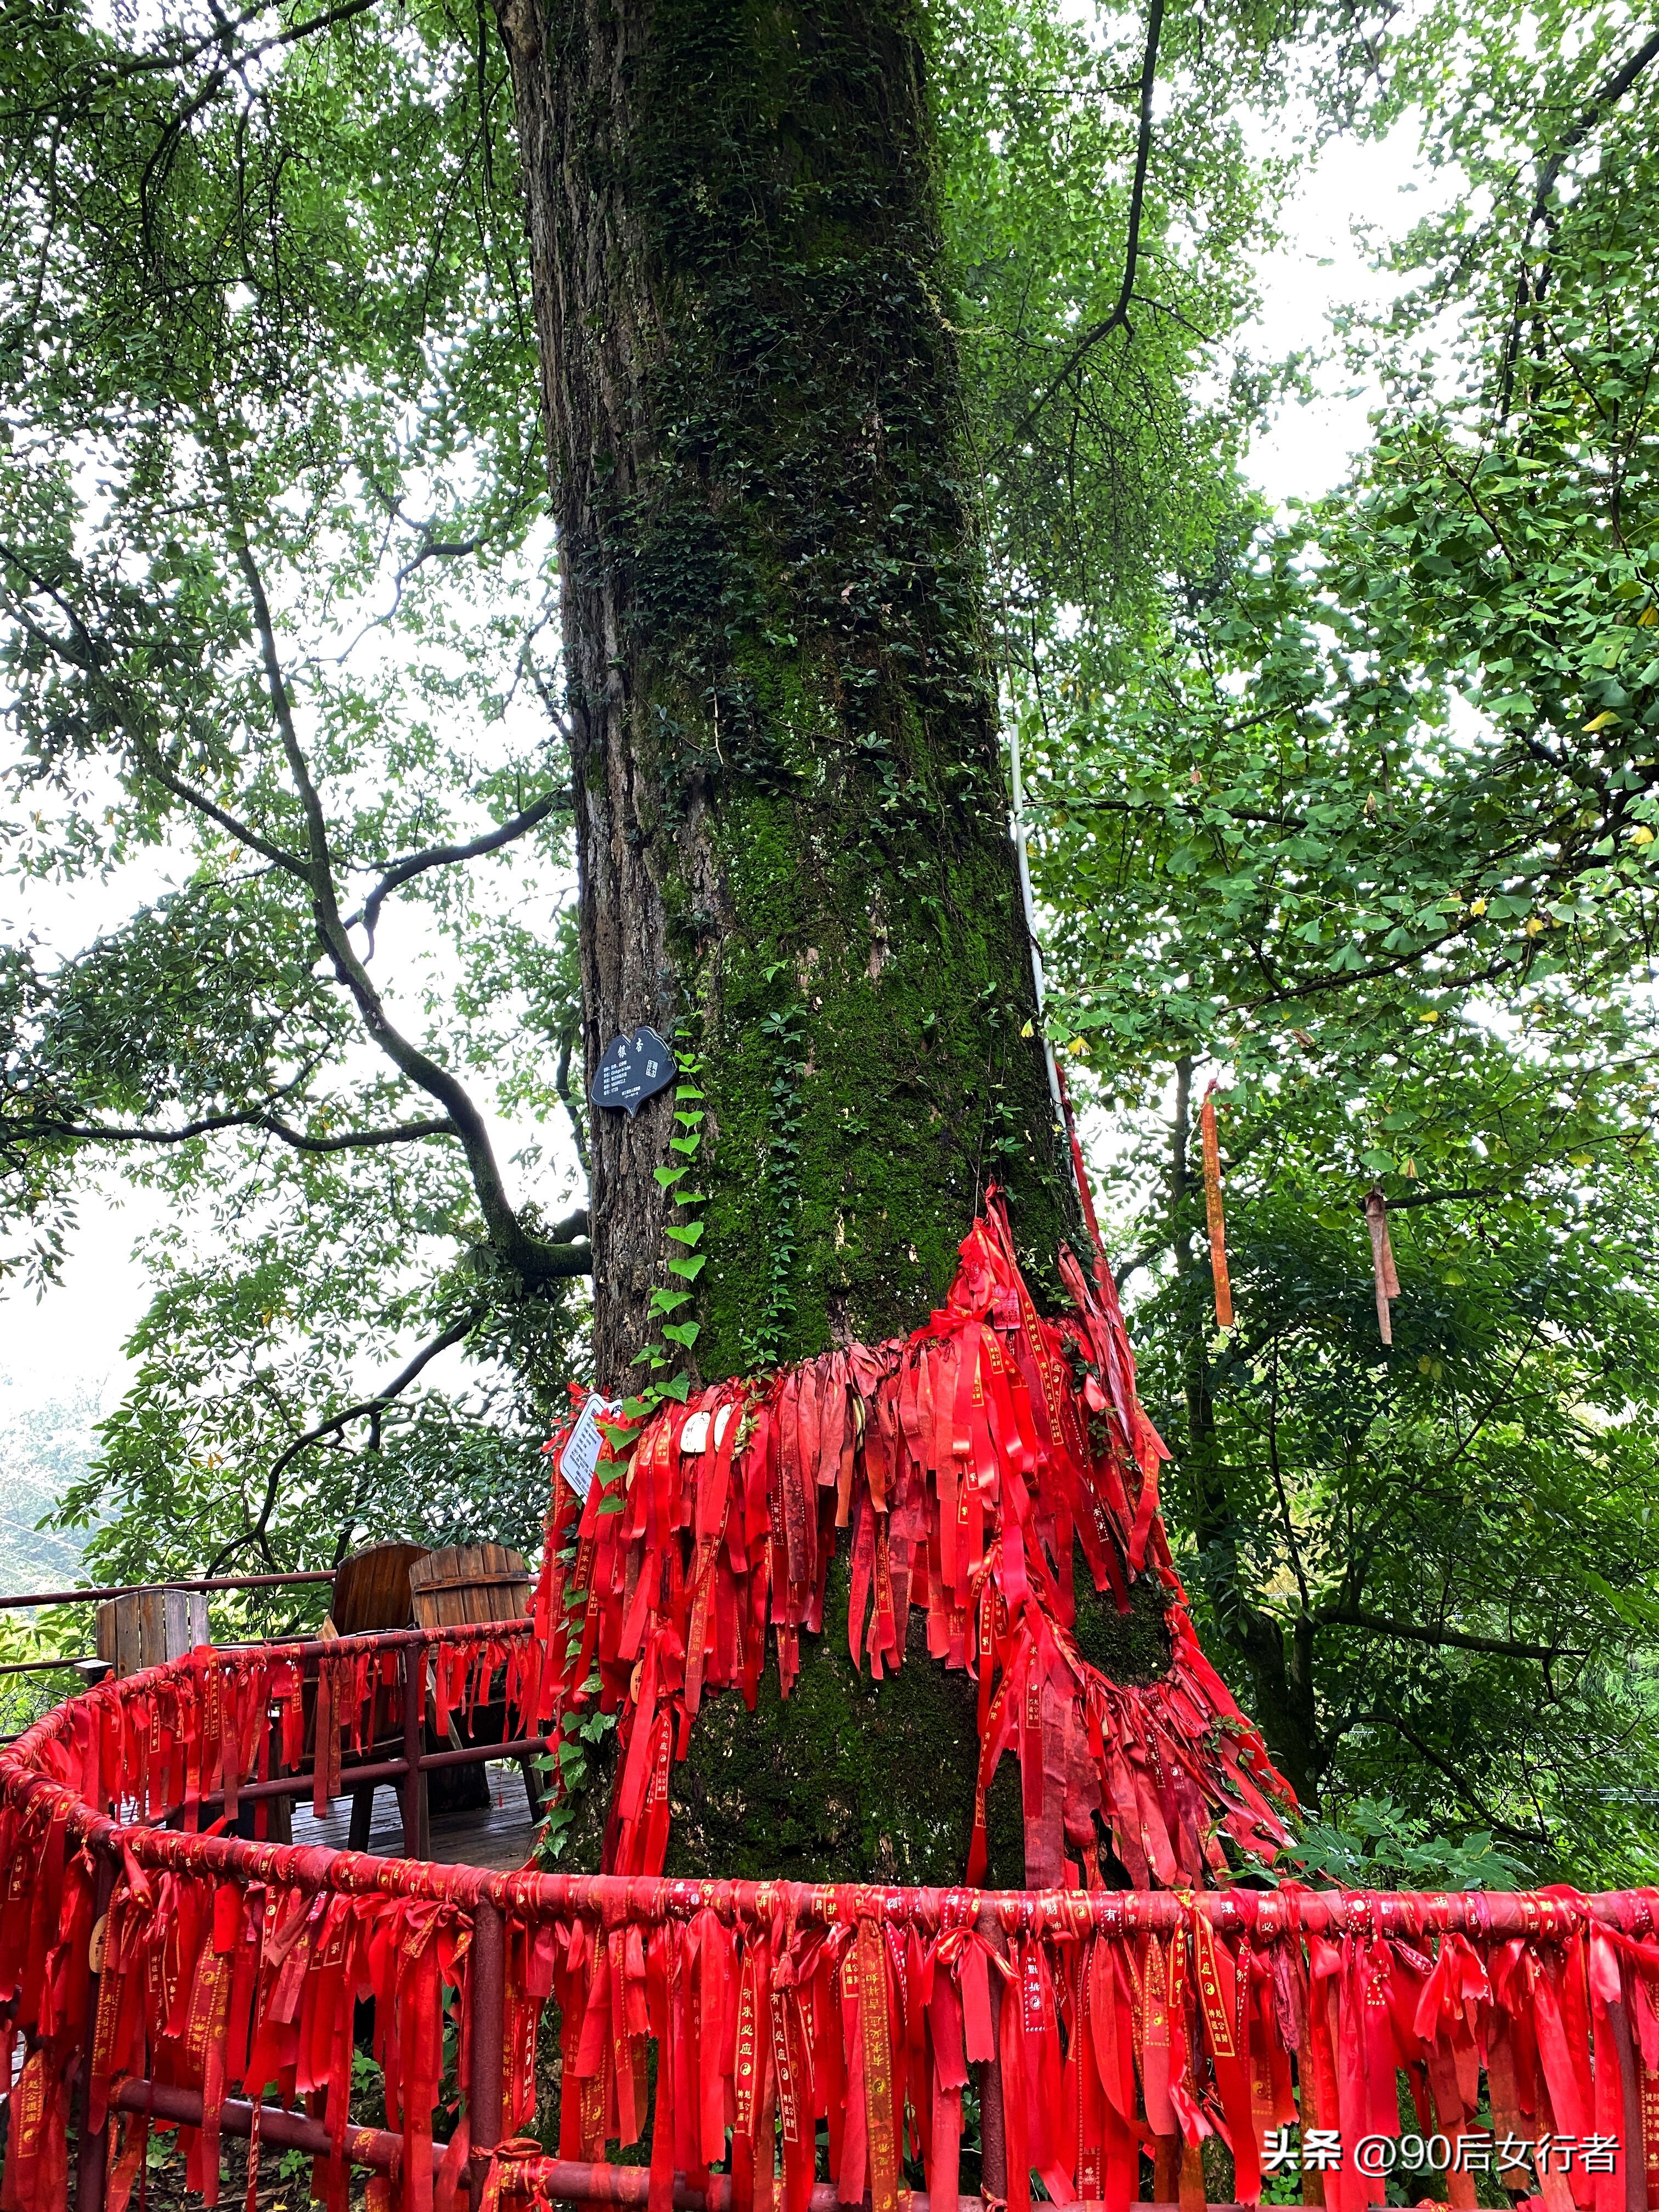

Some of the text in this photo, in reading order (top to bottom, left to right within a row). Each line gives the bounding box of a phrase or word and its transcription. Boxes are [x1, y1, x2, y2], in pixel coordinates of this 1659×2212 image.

[740, 1988, 754, 2056] 有求必应
[770, 1992, 787, 2061] 有求必应
[24, 2080, 39, 2123] 赵公祖庙
